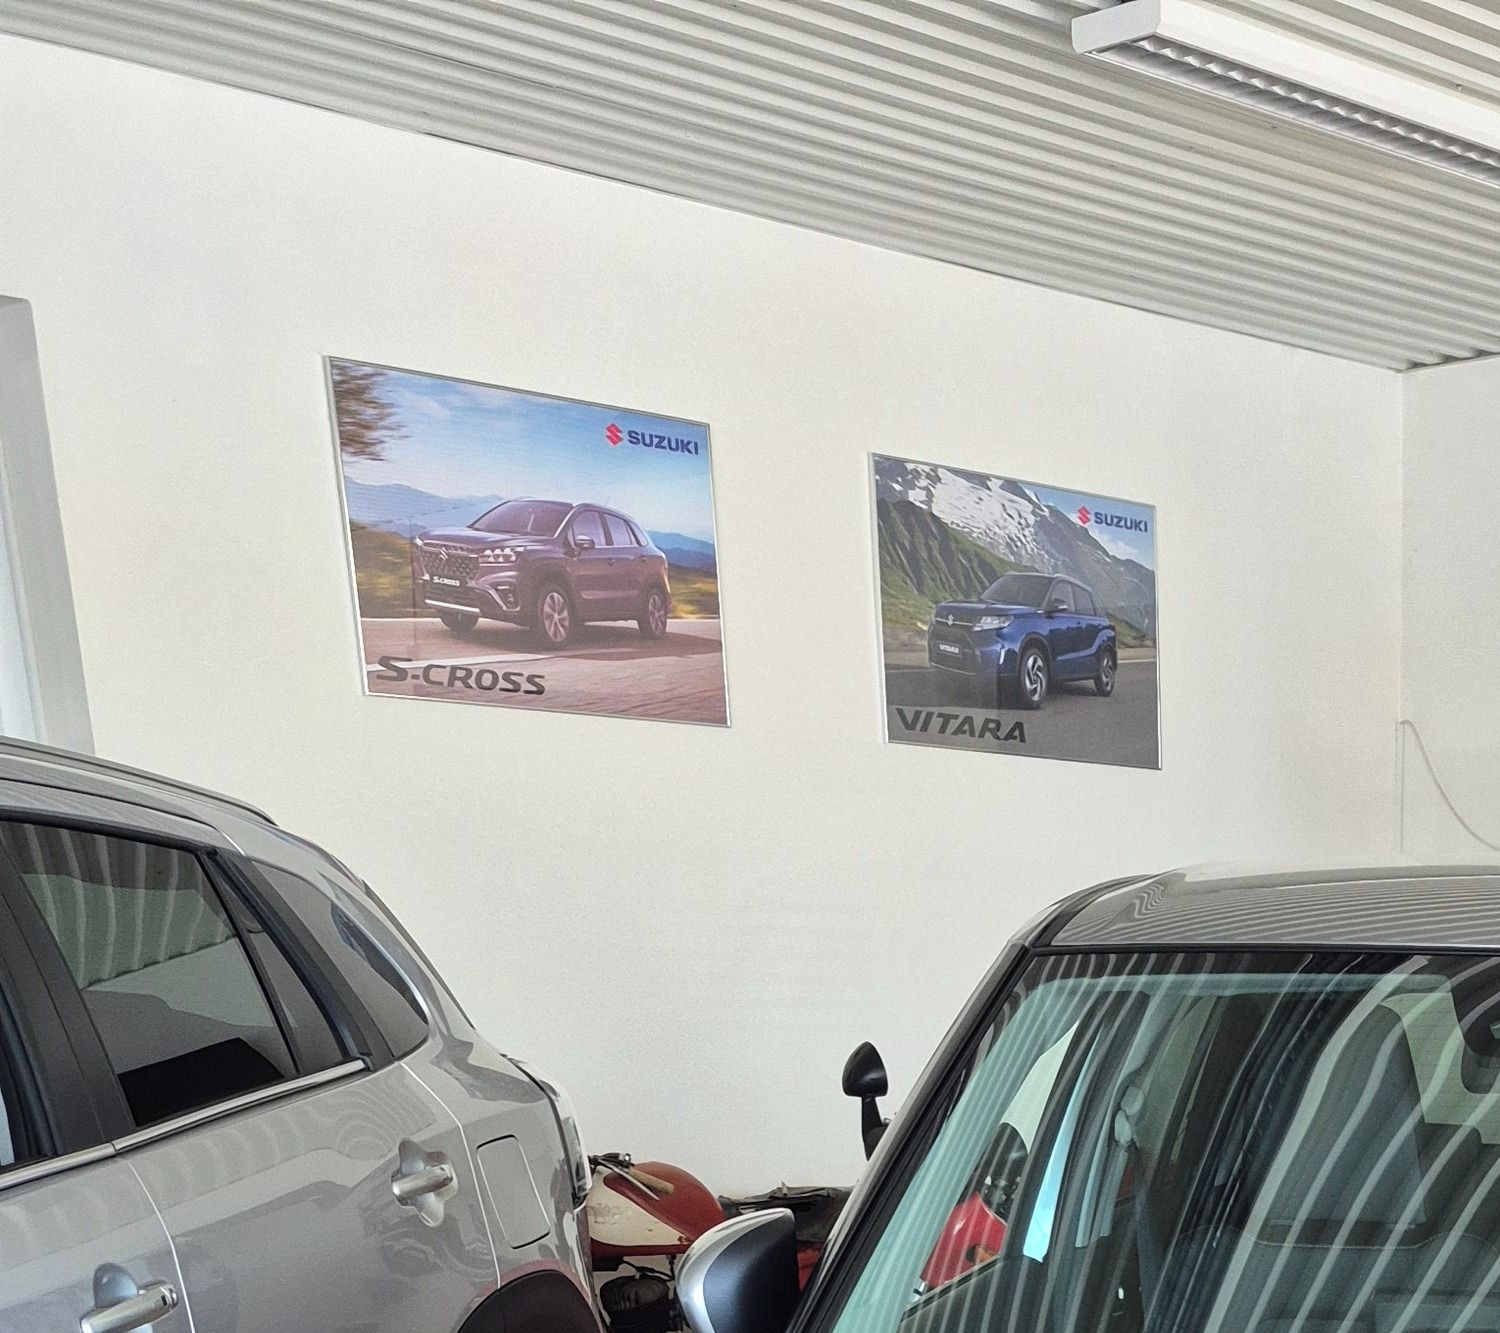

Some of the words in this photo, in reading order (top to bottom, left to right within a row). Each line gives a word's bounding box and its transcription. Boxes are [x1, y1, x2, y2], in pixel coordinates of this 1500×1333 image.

[626, 430, 700, 456] SUZUKI
[1093, 511, 1148, 533] SUZUKI
[376, 655, 546, 696] S-CROSS
[895, 707, 1027, 744] VITARA
